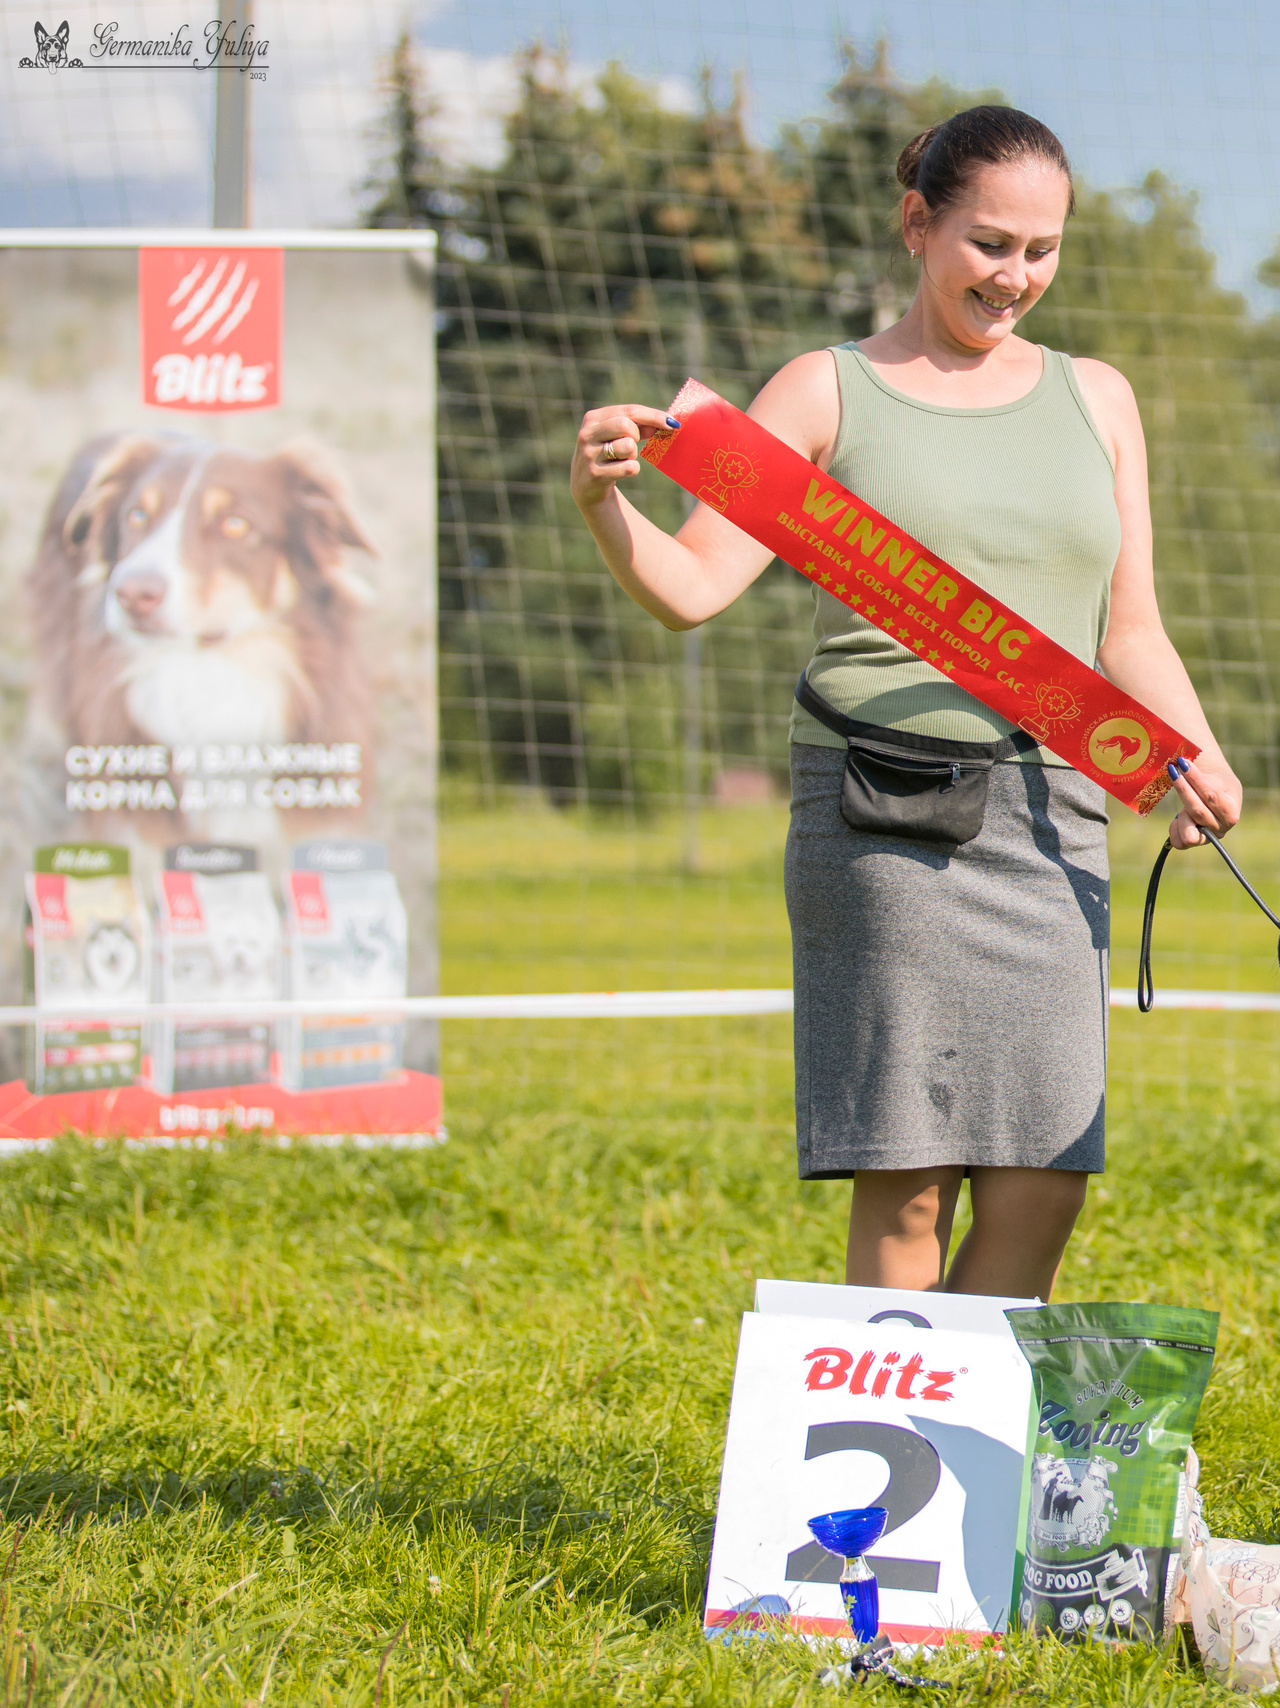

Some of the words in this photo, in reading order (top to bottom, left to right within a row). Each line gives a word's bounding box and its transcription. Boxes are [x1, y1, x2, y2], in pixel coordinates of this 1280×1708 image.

[152, 352, 268, 404] Blitz
[776, 511, 853, 572] ВЫСТАВКА
[855, 568, 903, 608] СОБАК
[903, 602, 940, 633] ВСЕХ
[940, 629, 991, 671] ПОРОД
[801, 477, 959, 613] WINNER
[957, 598, 1031, 661] BIG
[65, 744, 170, 777] СУХИЕ
[172, 744, 198, 774] И
[201, 742, 362, 775] ВЛАЖНЫЕ
[1080, 713, 1109, 761] РОССИЙСКАЯ
[1112, 757, 1155, 784] ФЕДЕРАЦИЯ
[252, 776, 363, 809] СОБАК
[1076, 1379, 1107, 1407] SUPER
[1038, 1399, 1149, 1457] Zooing
[785, 1420, 942, 1594] 2
[1023, 1559, 1043, 1586] DOG
[1045, 1569, 1093, 1590] FOOD
